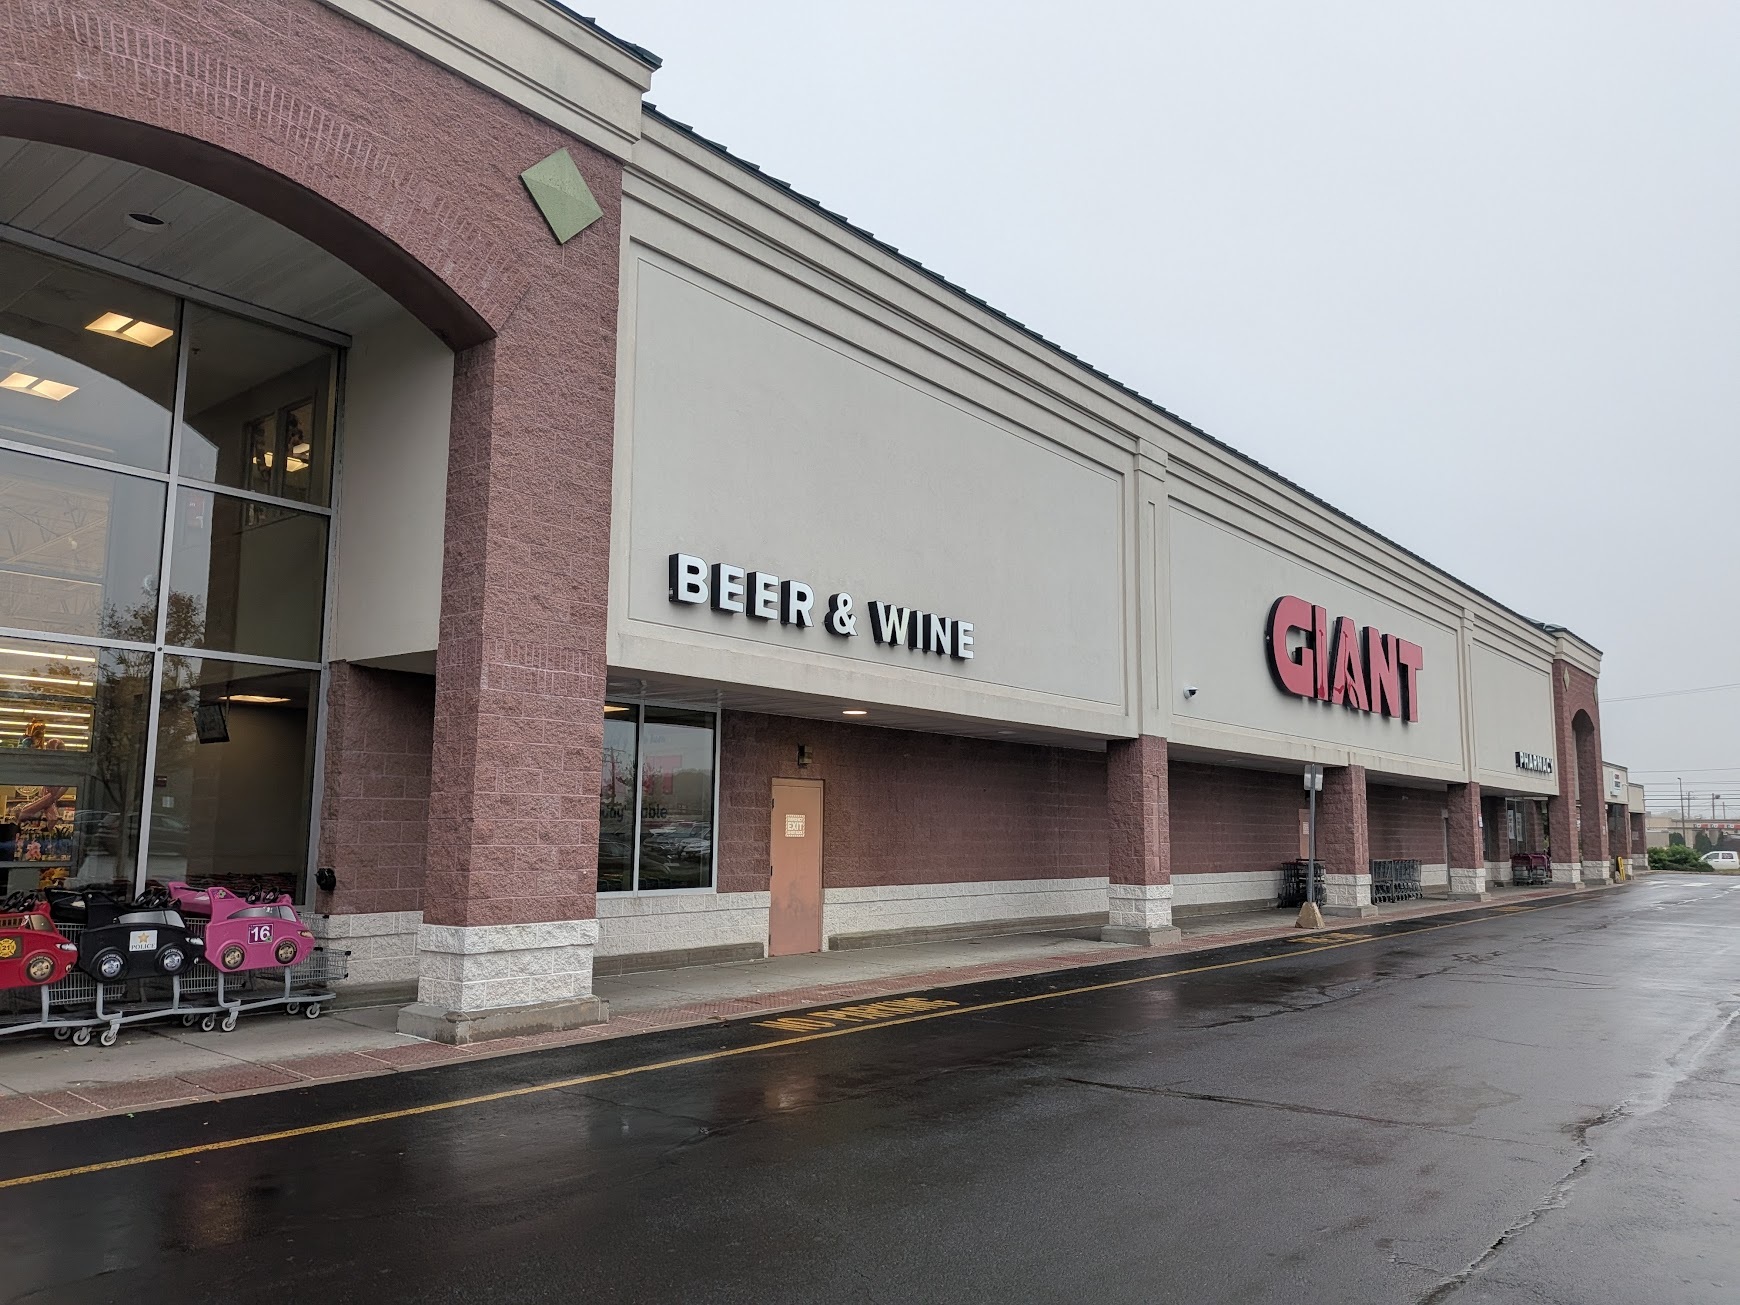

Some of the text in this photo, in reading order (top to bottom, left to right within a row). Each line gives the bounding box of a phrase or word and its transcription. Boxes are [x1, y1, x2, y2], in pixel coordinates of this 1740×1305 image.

[669, 552, 975, 660] BEER & WINE
[1266, 595, 1423, 723] GIANT
[787, 821, 804, 831] EXIT
[250, 925, 271, 942] 16
[131, 943, 156, 951] POLICE
